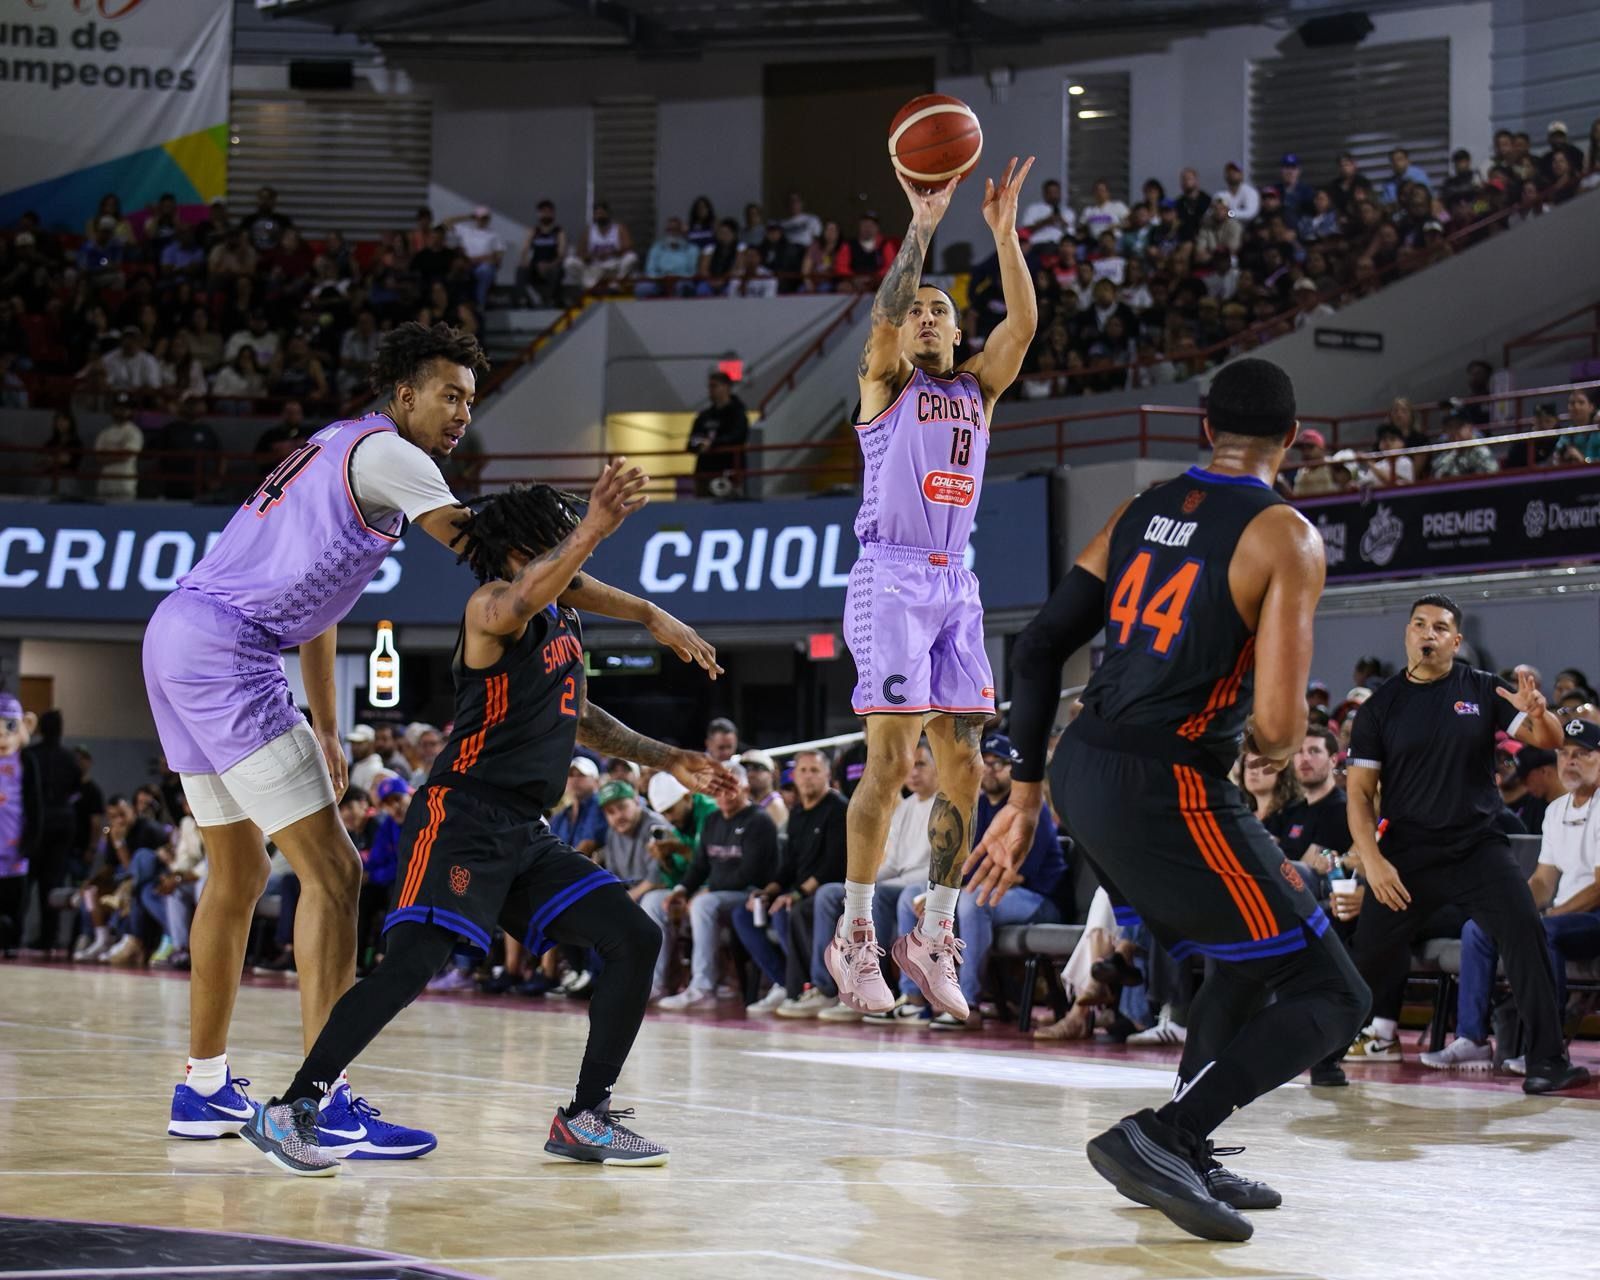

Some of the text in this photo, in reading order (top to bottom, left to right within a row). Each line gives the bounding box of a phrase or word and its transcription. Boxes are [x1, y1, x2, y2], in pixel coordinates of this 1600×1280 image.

[71, 22, 121, 51] de
[917, 390, 981, 431] CRIOL
[950, 426, 972, 468] 13
[1422, 507, 1497, 539] PREMIER
[1548, 501, 1600, 531] Dewar
[1109, 549, 1202, 656] 44
